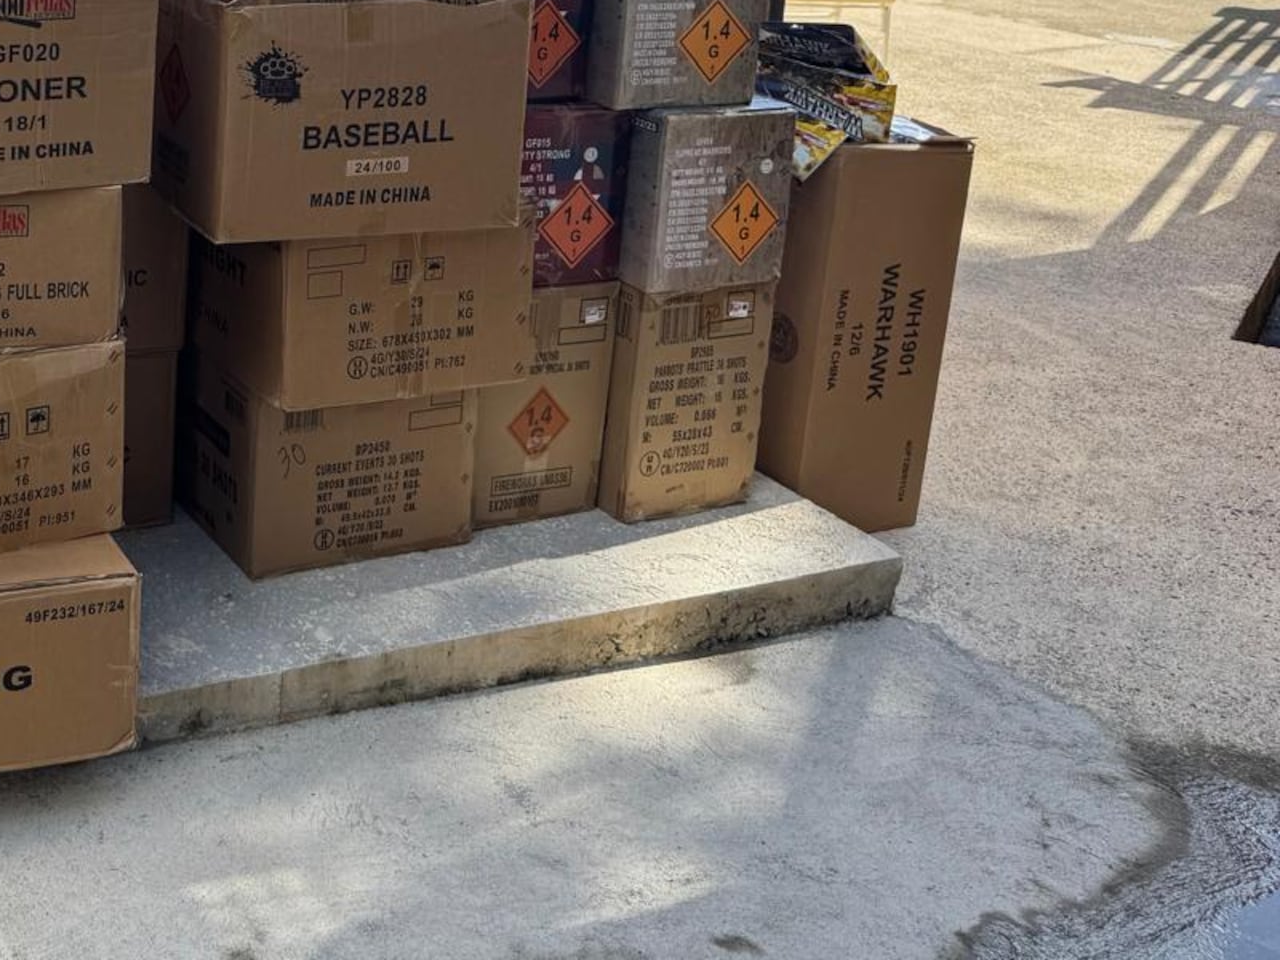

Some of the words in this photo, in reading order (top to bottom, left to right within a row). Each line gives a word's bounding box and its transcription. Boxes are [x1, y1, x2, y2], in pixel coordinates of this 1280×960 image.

[532, 20, 560, 42] 1.4
[702, 20, 731, 41] 1.4
[708, 45, 719, 58] G
[340, 85, 428, 110] YP2828
[4, 115, 47, 132] 18/1
[302, 119, 455, 151] BASEBALL
[11, 146, 29, 160] IN
[36, 141, 94, 159] CHINA
[354, 160, 401, 173] 24/100
[310, 192, 355, 208] MADE
[359, 191, 376, 205] IN
[380, 186, 431, 204] CHINA
[565, 205, 593, 225] 1.4
[733, 201, 759, 223] 1.4
[570, 230, 581, 242] G
[739, 227, 749, 240] G
[7, 284, 41, 301] FULL
[47, 281, 89, 299] BRICK
[459, 290, 474, 302] KG
[457, 307, 473, 320] KG
[835, 290, 850, 329] MADE
[866, 263, 902, 402] WARHAWK
[898, 289, 926, 376] WH1901
[827, 350, 841, 391] CHINA
[527, 405, 553, 427] 1.4
[15, 456, 30, 470] 17
[72, 443, 91, 458] KG
[278, 444, 306, 479] 30
[316, 462, 352, 476] CURRENT
[355, 457, 384, 471] EVENTS
[400, 450, 424, 465] SHOTS
[15, 474, 30, 488] 16
[72, 461, 90, 475] KG
[72, 478, 92, 492] MM
[25, 599, 125, 624] 49F232/167/24
